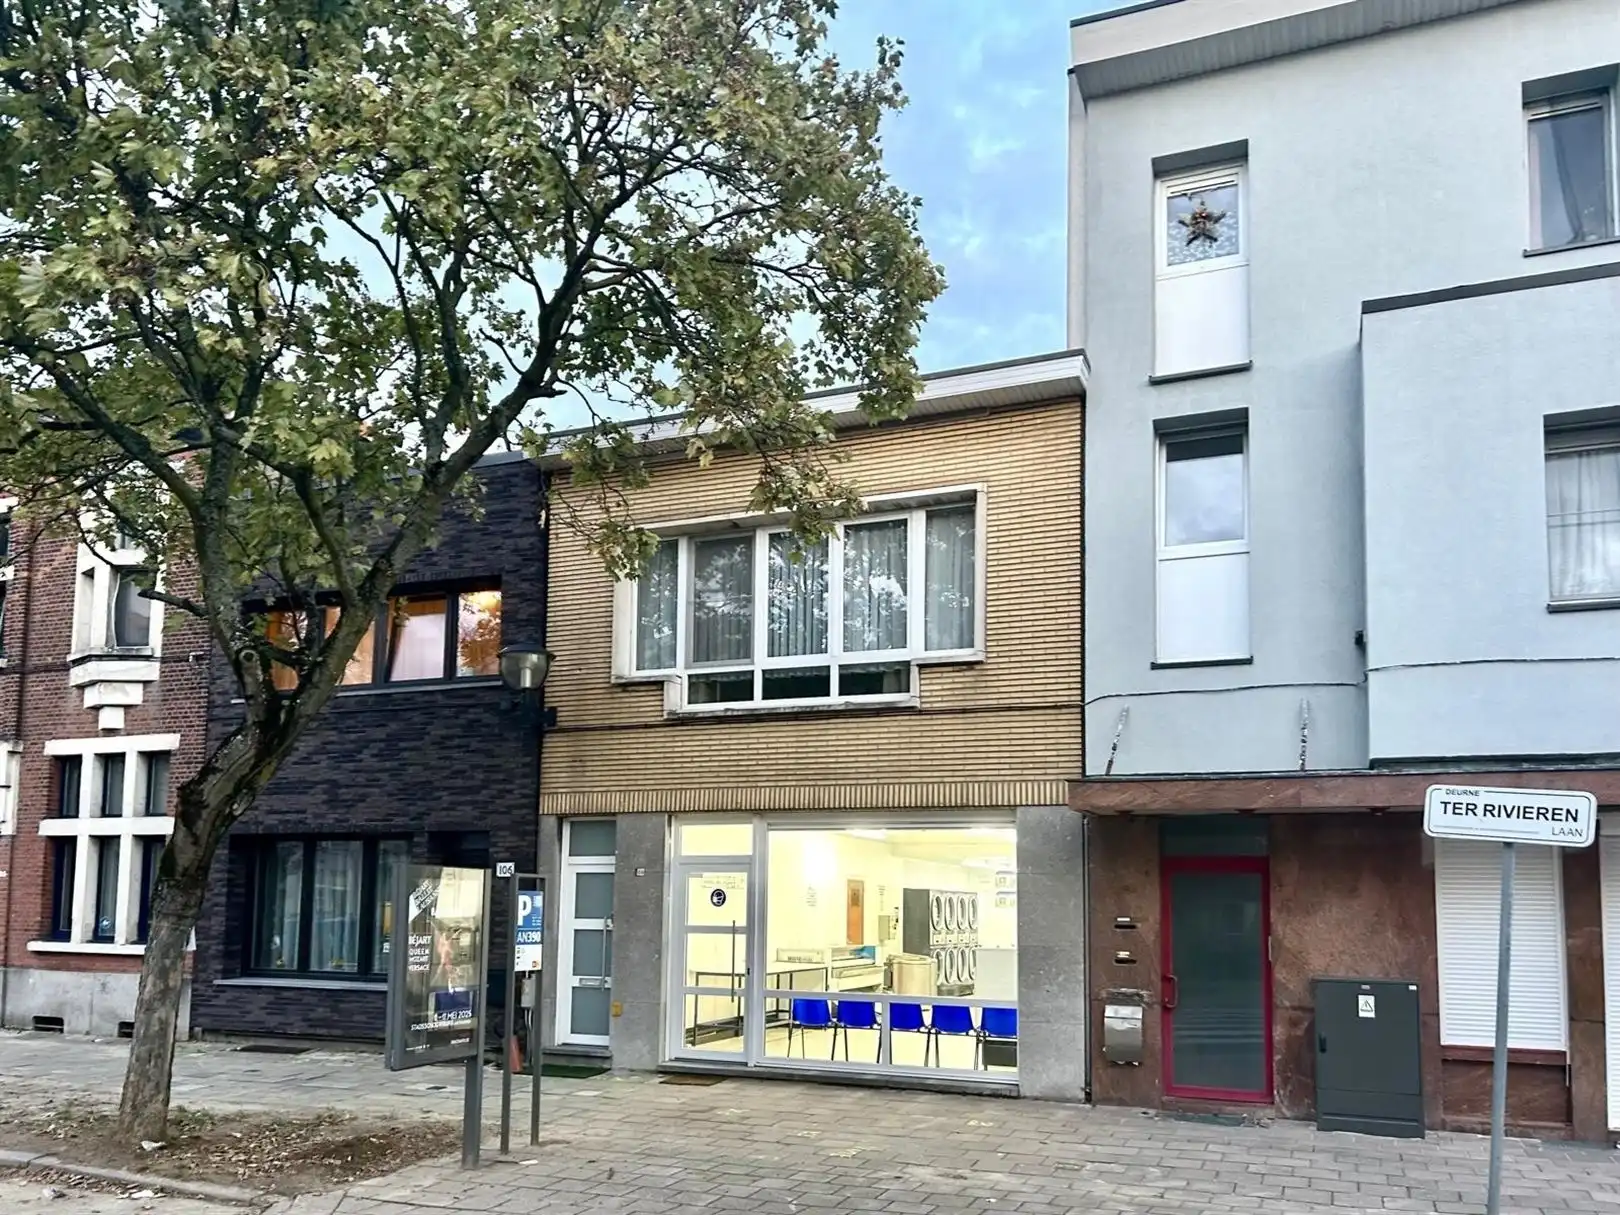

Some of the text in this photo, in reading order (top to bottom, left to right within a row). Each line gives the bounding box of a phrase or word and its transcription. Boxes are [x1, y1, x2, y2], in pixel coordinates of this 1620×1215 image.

[1445, 788, 1480, 797] DEURNE
[1440, 801, 1578, 822] TER RIVIEREN
[1551, 827, 1583, 837] LAAN
[499, 865, 513, 875] 106
[517, 895, 532, 926] P
[408, 934, 431, 947] BÉJART
[517, 931, 541, 942] AN390
